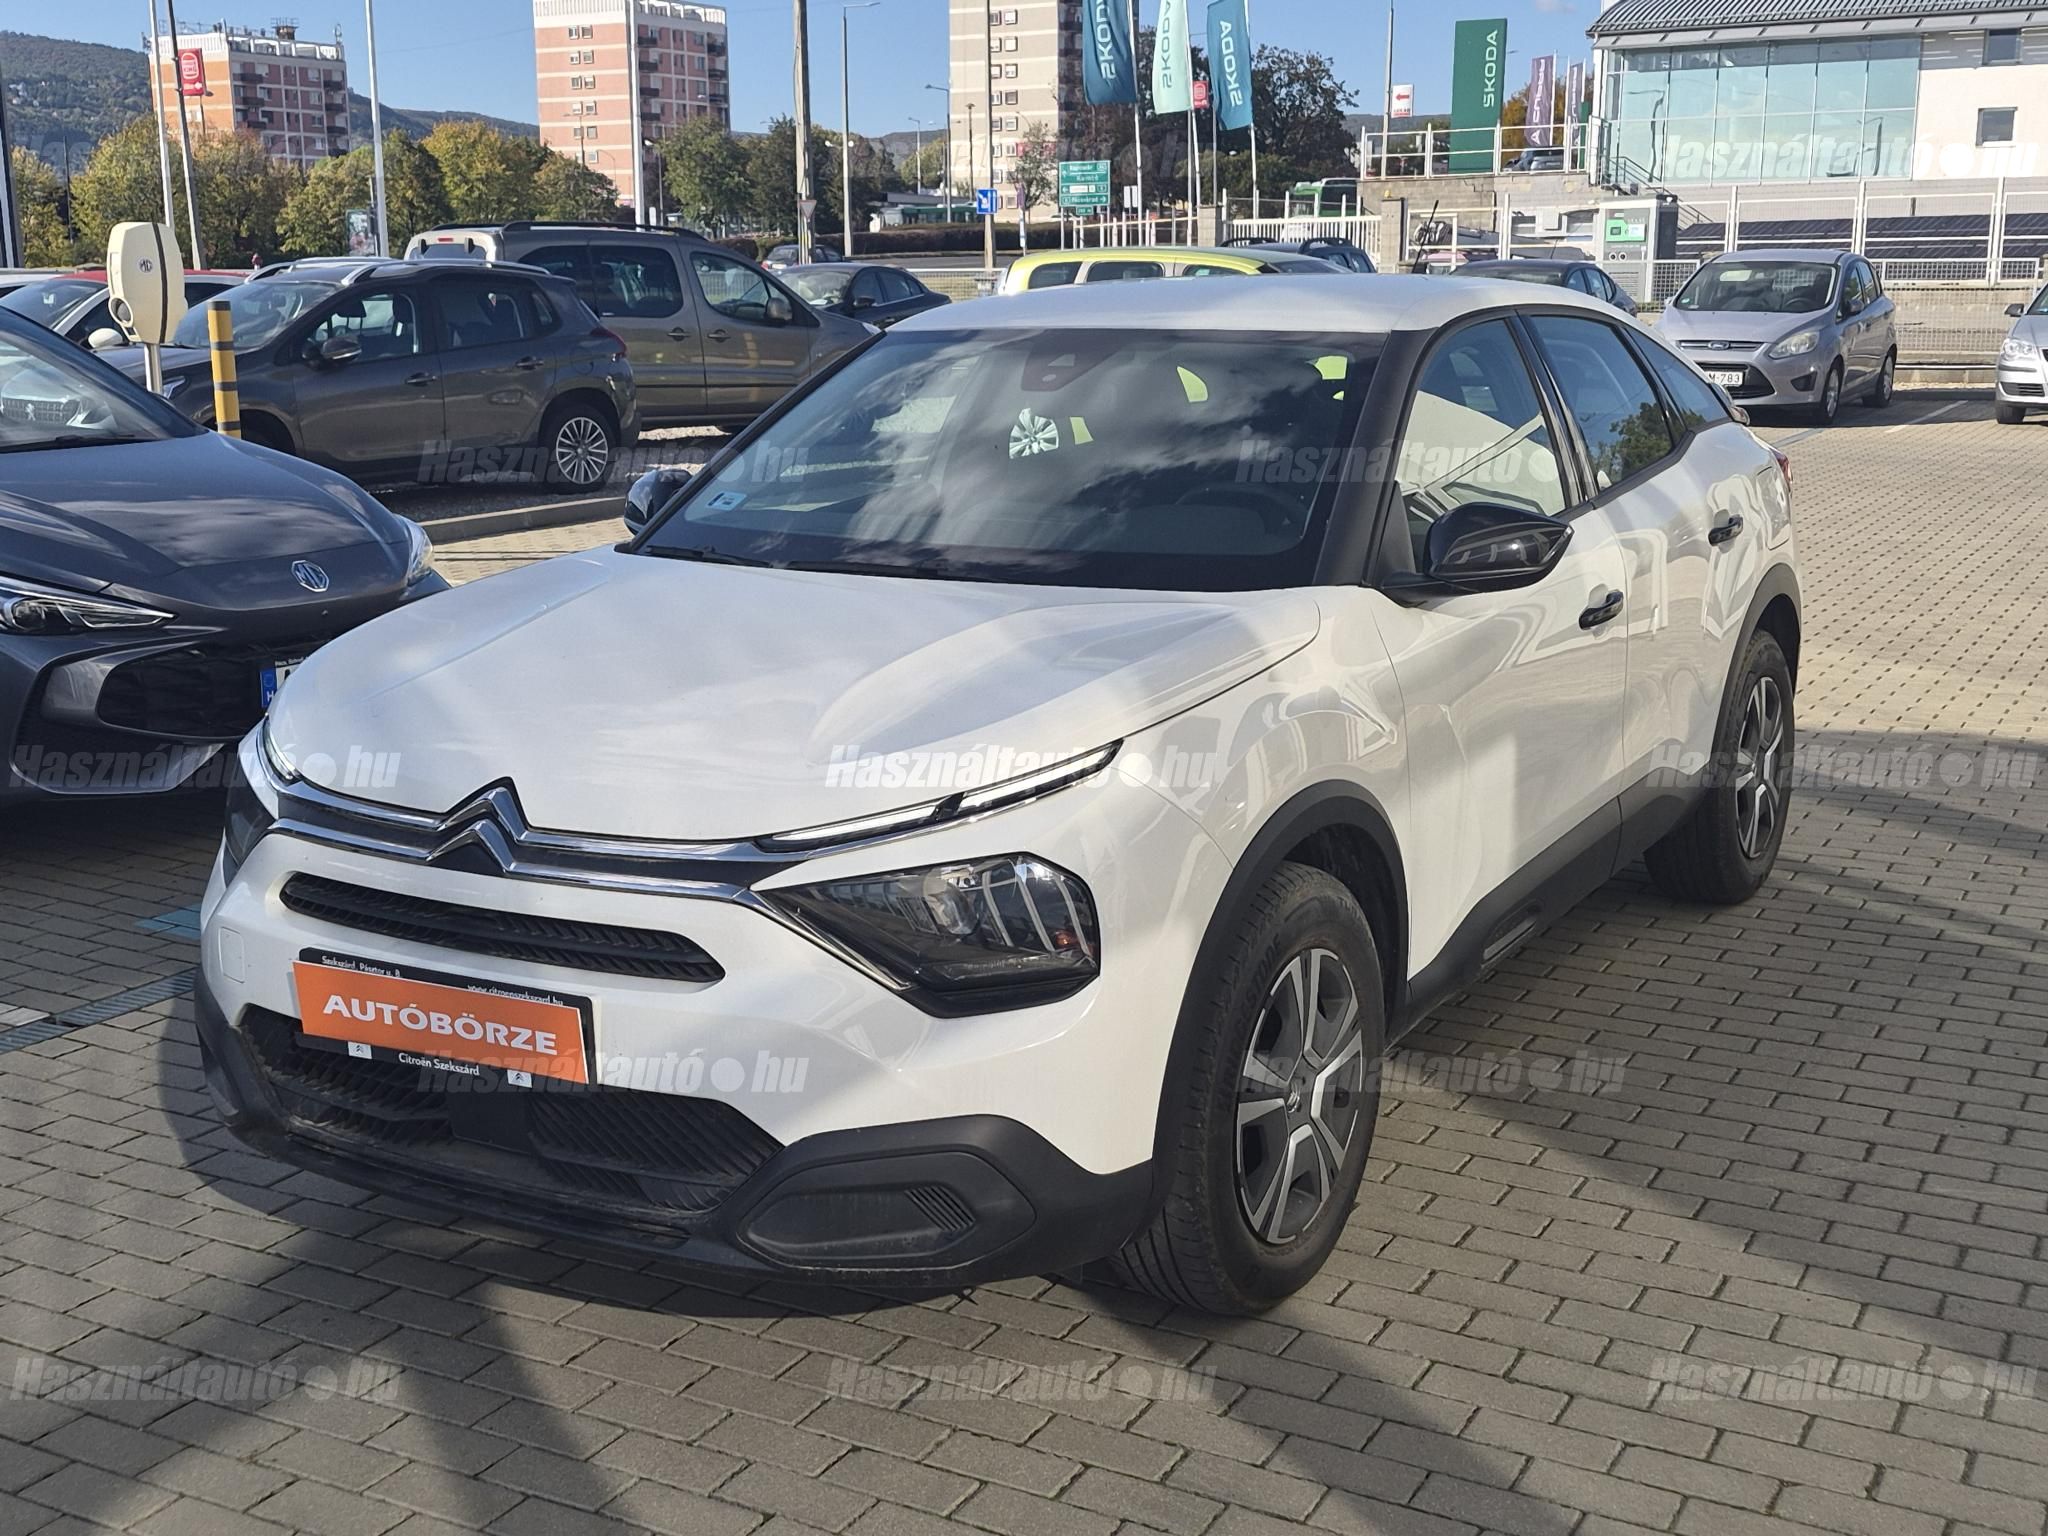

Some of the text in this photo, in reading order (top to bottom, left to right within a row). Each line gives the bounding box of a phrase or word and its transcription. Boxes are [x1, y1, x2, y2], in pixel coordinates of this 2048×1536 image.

[322, 994, 558, 1056] AUTÓBÖRZE
[398, 1052, 480, 1076] Citroën Szekszárd
